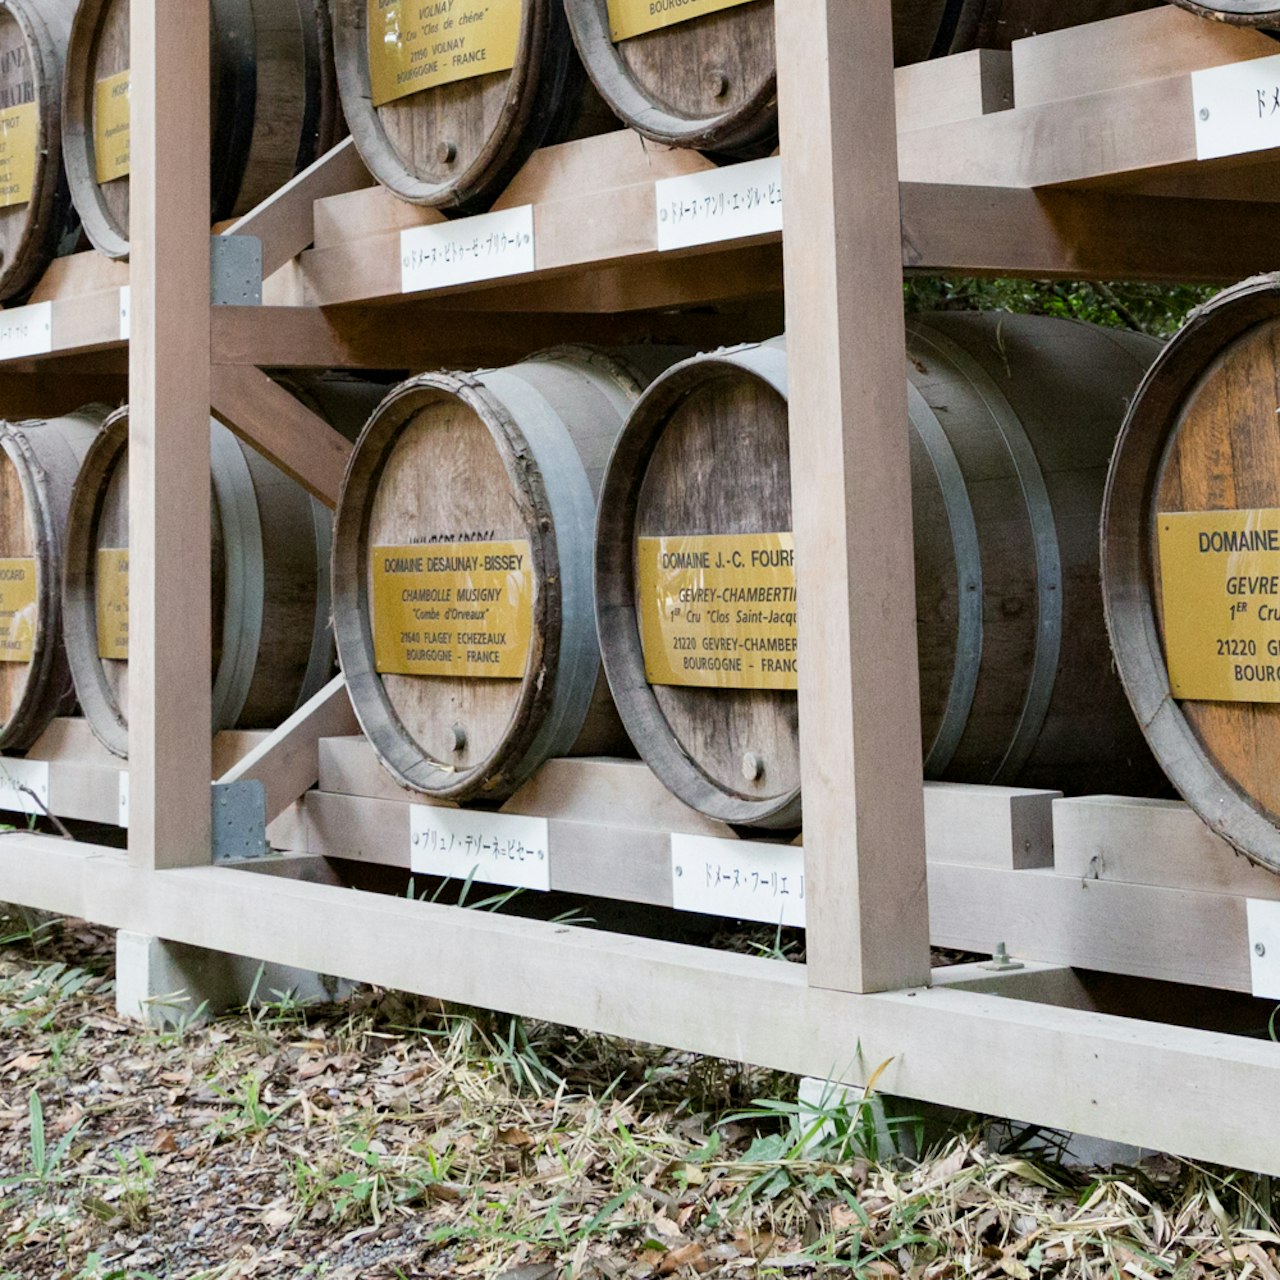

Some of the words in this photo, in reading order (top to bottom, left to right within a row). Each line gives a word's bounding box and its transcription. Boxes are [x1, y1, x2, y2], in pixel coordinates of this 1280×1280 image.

[406, 31, 417, 42] Cru
[444, 16, 454, 29] de
[432, 36, 466, 55] VOLNAY
[396, 61, 438, 84] BOURGOGNE
[452, 49, 486, 67] FRANCE
[1198, 529, 1280, 554] DOMAINE
[384, 558, 423, 573] DOMAINE
[427, 555, 523, 573] DESAUNAY-BISSEY
[662, 552, 710, 569] DOMAINE
[715, 551, 745, 568] J.-C.
[402, 589, 451, 602] CHAMBOLLE
[457, 588, 502, 601] MUSIGNY
[687, 610, 700, 623] Cru
[1229, 602, 1247, 621] 1ER
[424, 632, 452, 644] FLAGEY
[457, 632, 506, 645] ECHEZEAUX
[673, 637, 696, 650] 21220
[1216, 638, 1256, 656] 21220
[407, 649, 452, 661] BOURGOGNE
[467, 650, 500, 663] FRANCE
[683, 657, 741, 671] BOURGOGNE
